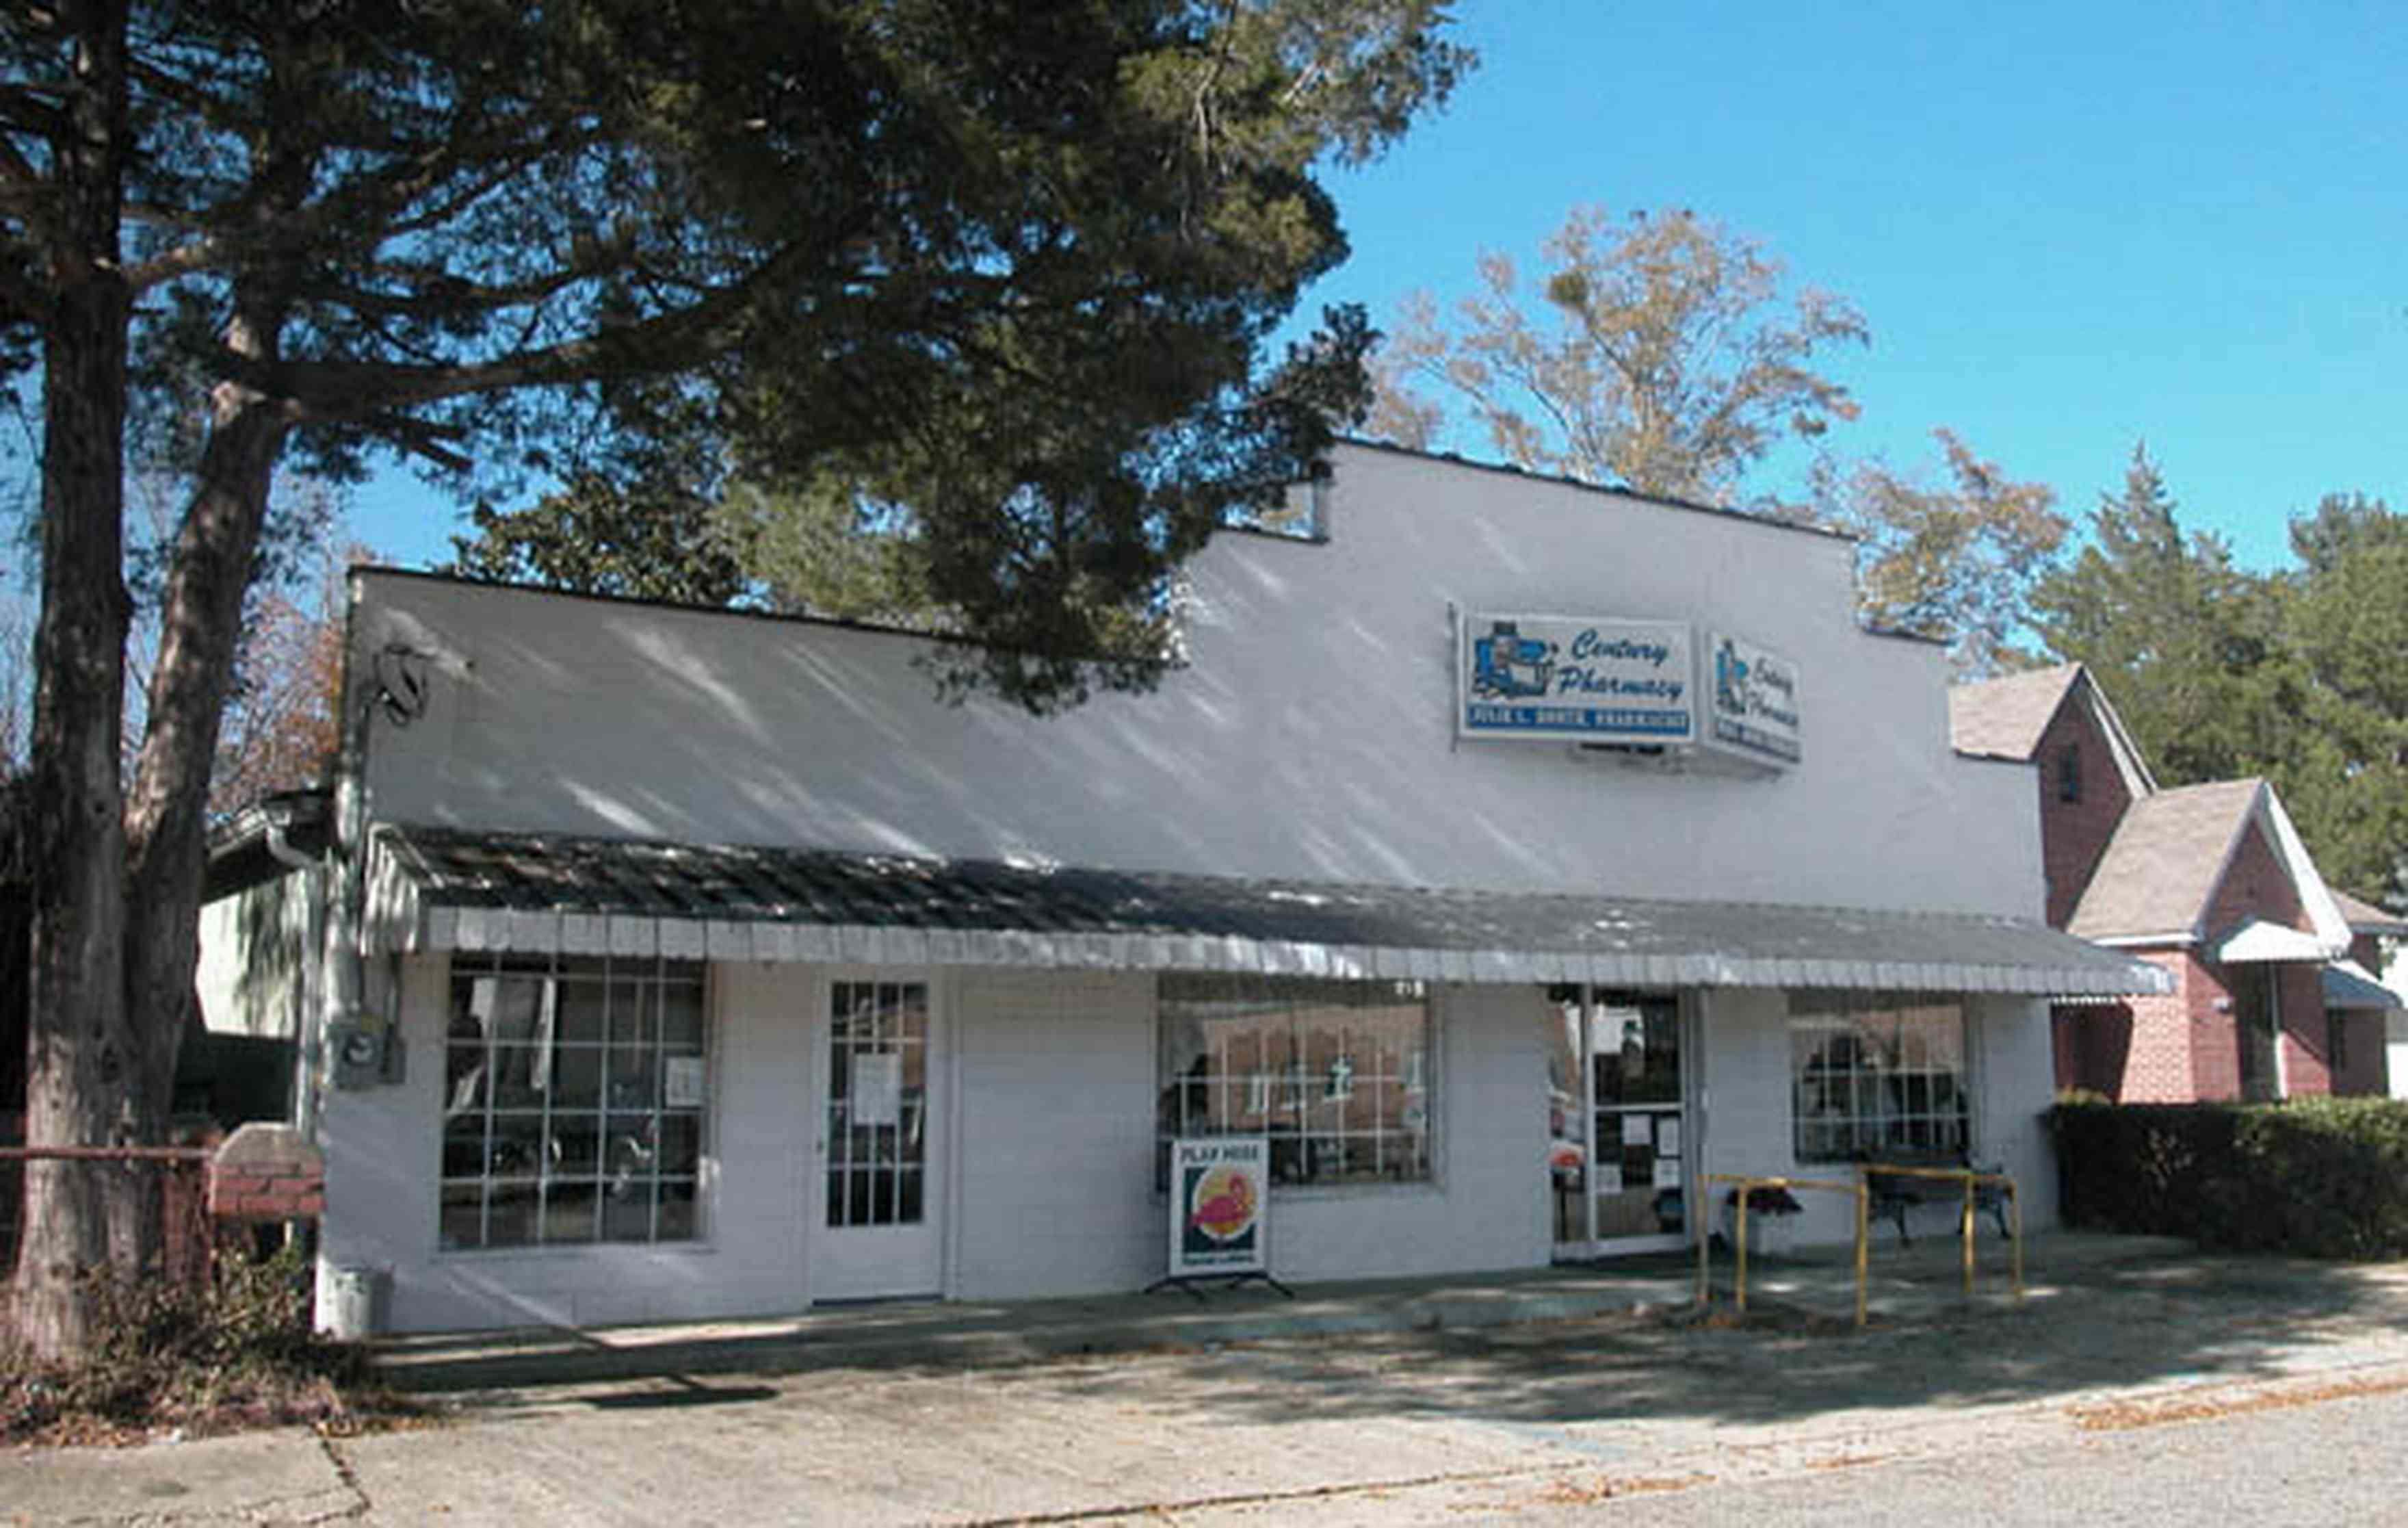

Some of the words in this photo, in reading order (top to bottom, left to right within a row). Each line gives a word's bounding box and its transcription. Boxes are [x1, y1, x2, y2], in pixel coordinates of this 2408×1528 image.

[1571, 627, 1668, 666] Century
[1558, 665, 1684, 703] Pharmacy
[1181, 1145, 1219, 1162] PLAY
